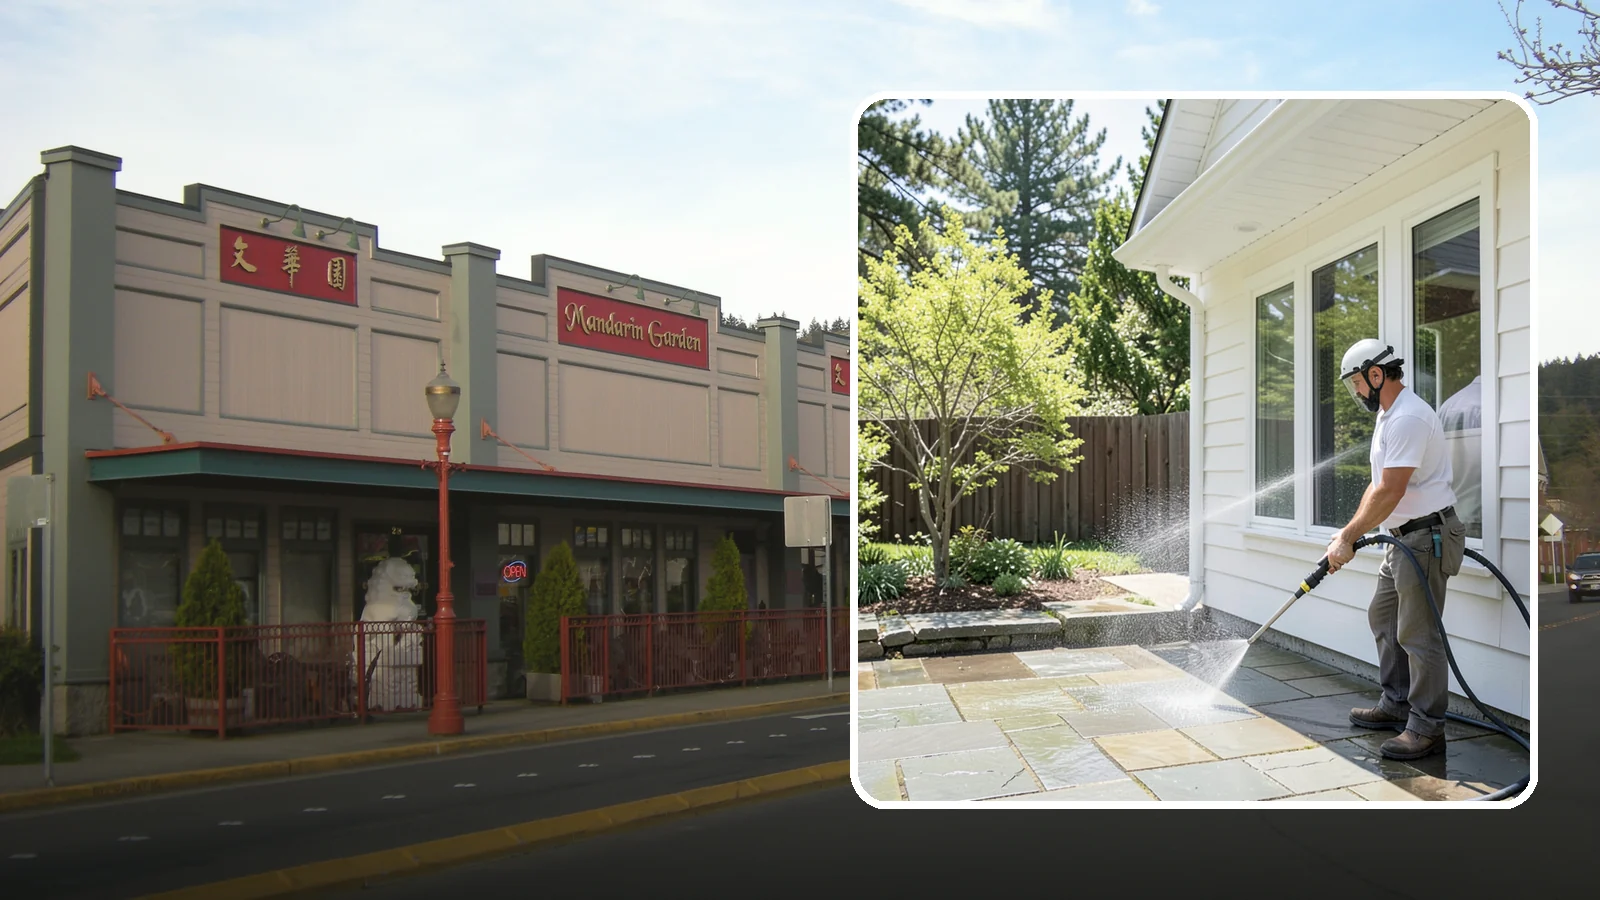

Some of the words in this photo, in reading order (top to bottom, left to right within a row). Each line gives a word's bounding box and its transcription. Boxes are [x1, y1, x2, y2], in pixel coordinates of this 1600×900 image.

[231, 235, 347, 291] 文華園
[564, 302, 644, 340] Mandarin
[647, 320, 701, 352] Garden
[503, 565, 527, 578] OPEN
